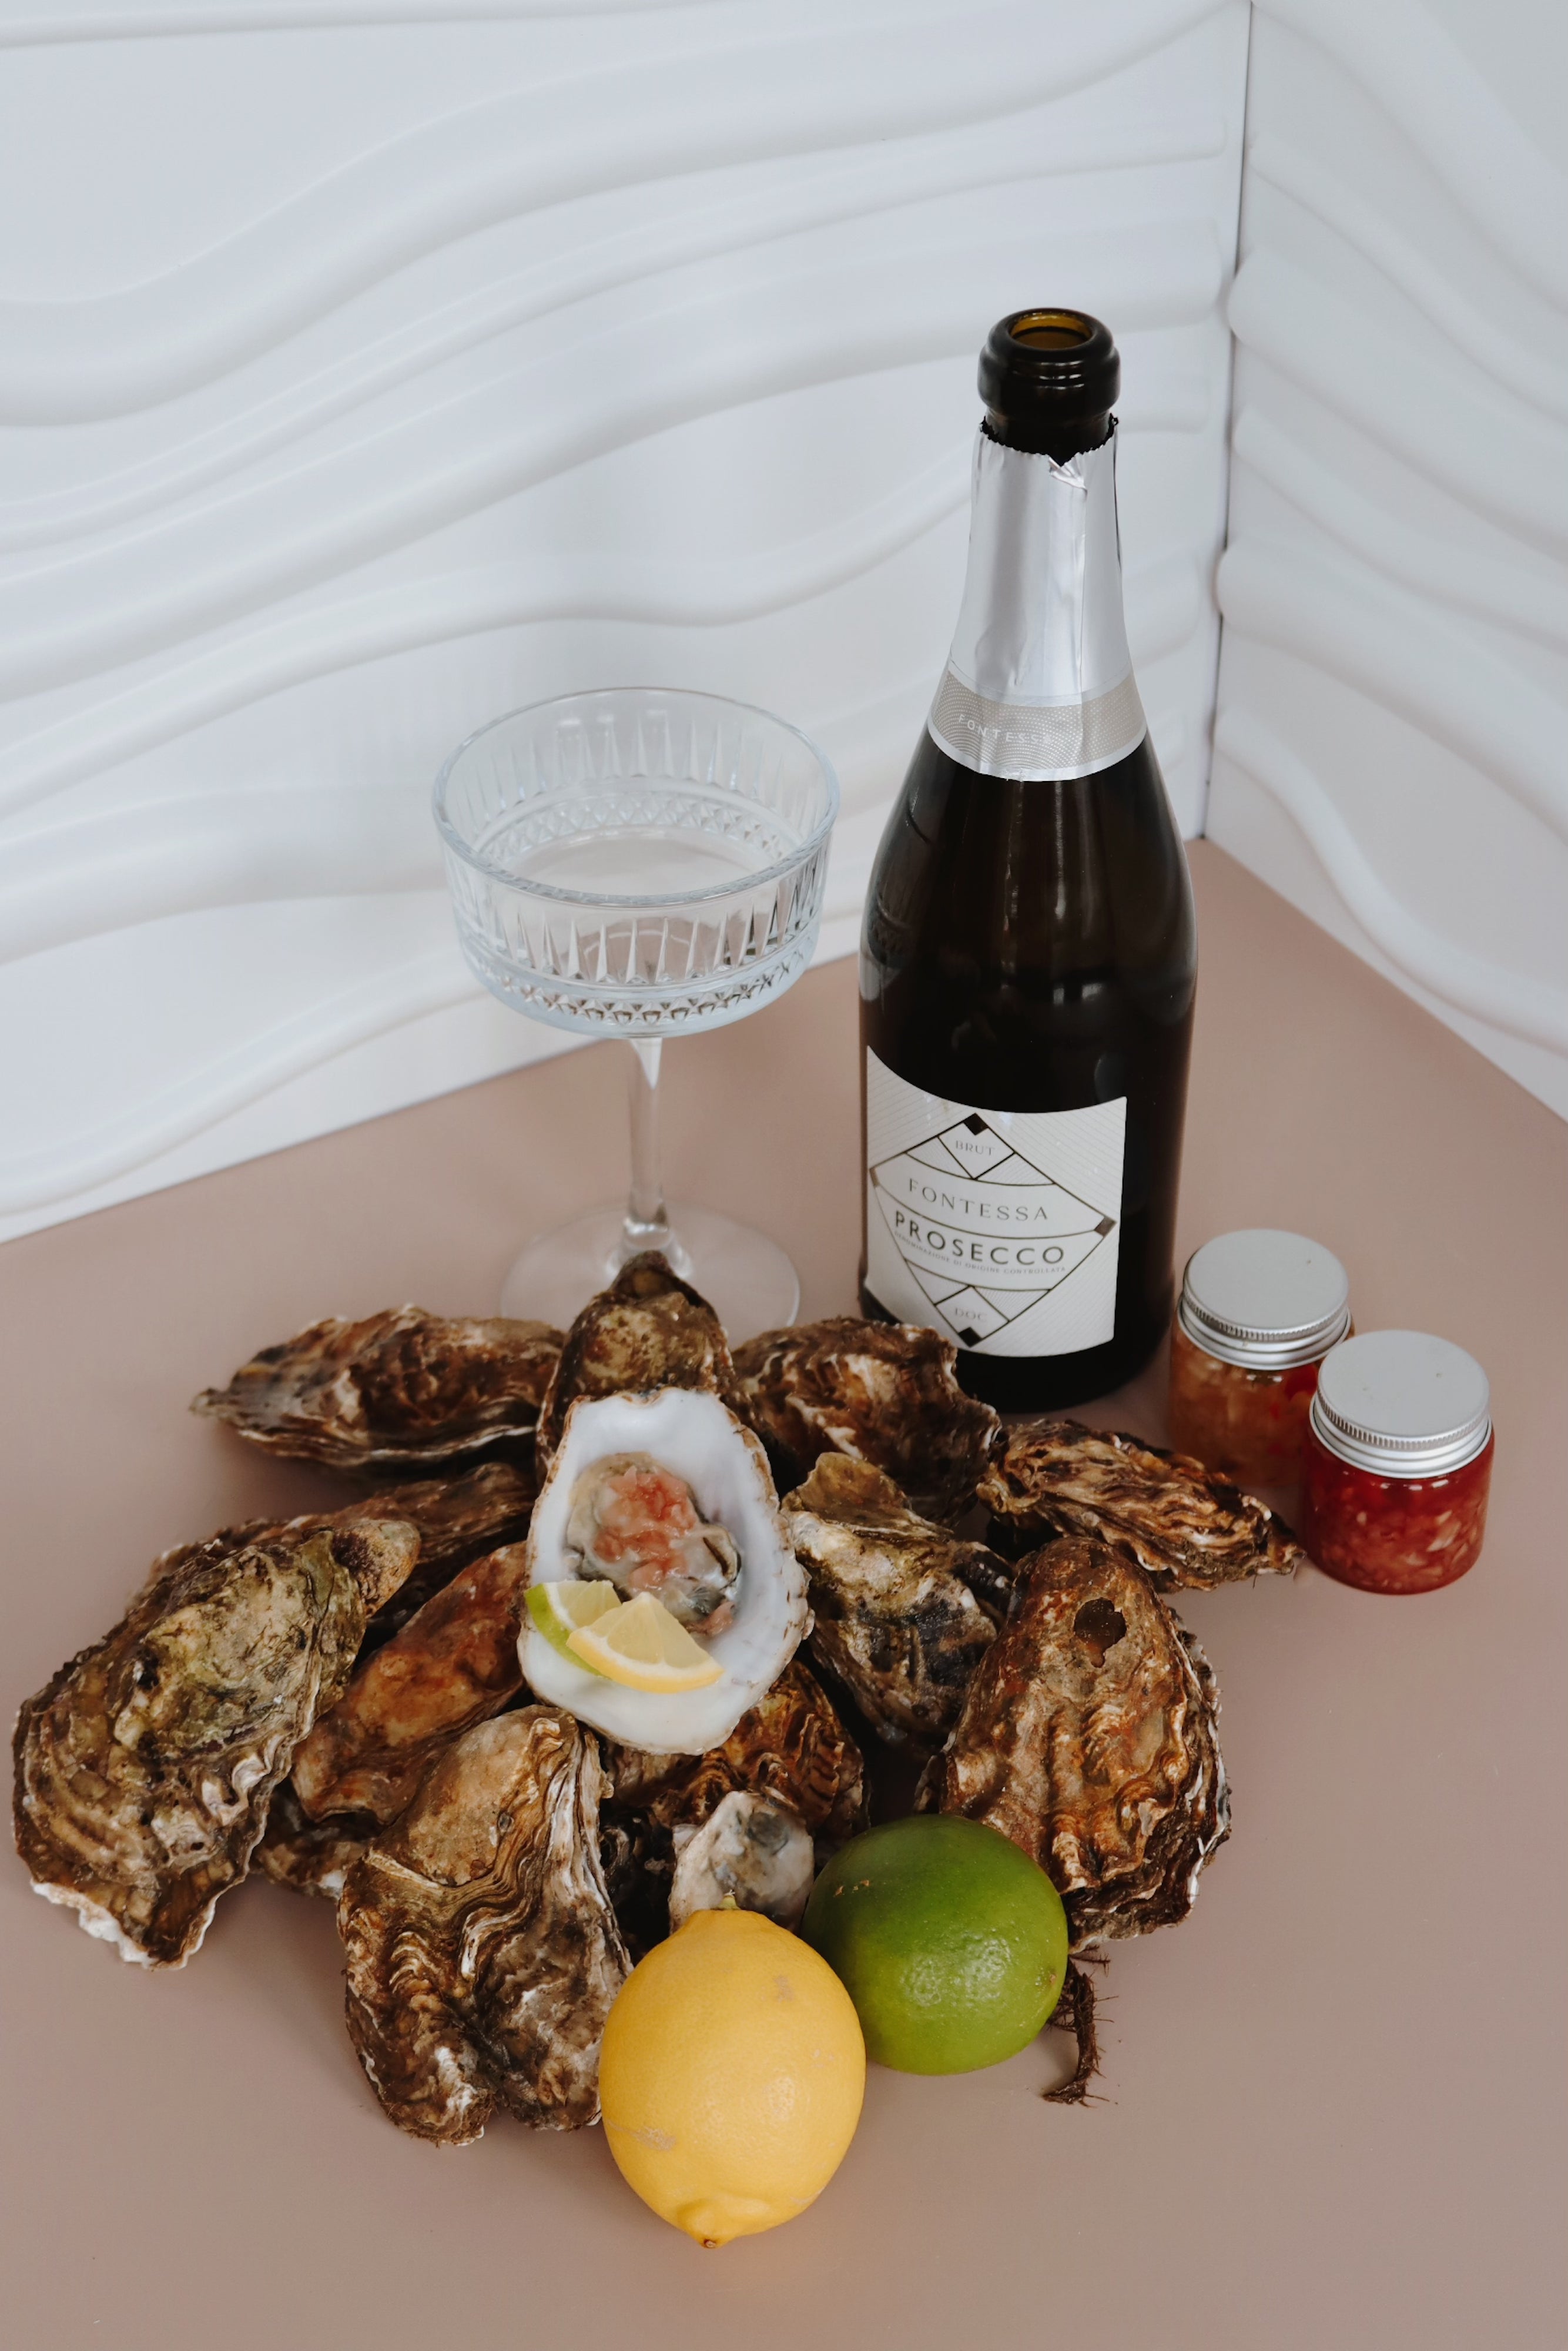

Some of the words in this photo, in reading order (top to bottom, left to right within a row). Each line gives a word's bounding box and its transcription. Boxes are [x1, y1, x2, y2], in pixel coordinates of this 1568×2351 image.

[959, 714, 1052, 745] FONTESSA
[956, 1140, 996, 1156] BRUT
[909, 1178, 1048, 1221] FONTESSA
[896, 1210, 1064, 1265] PROSECCO
[965, 1262, 1000, 1274] ORIGINE
[1003, 1266, 1066, 1275] CONTROLLATA
[955, 1307, 987, 1323] DOC
